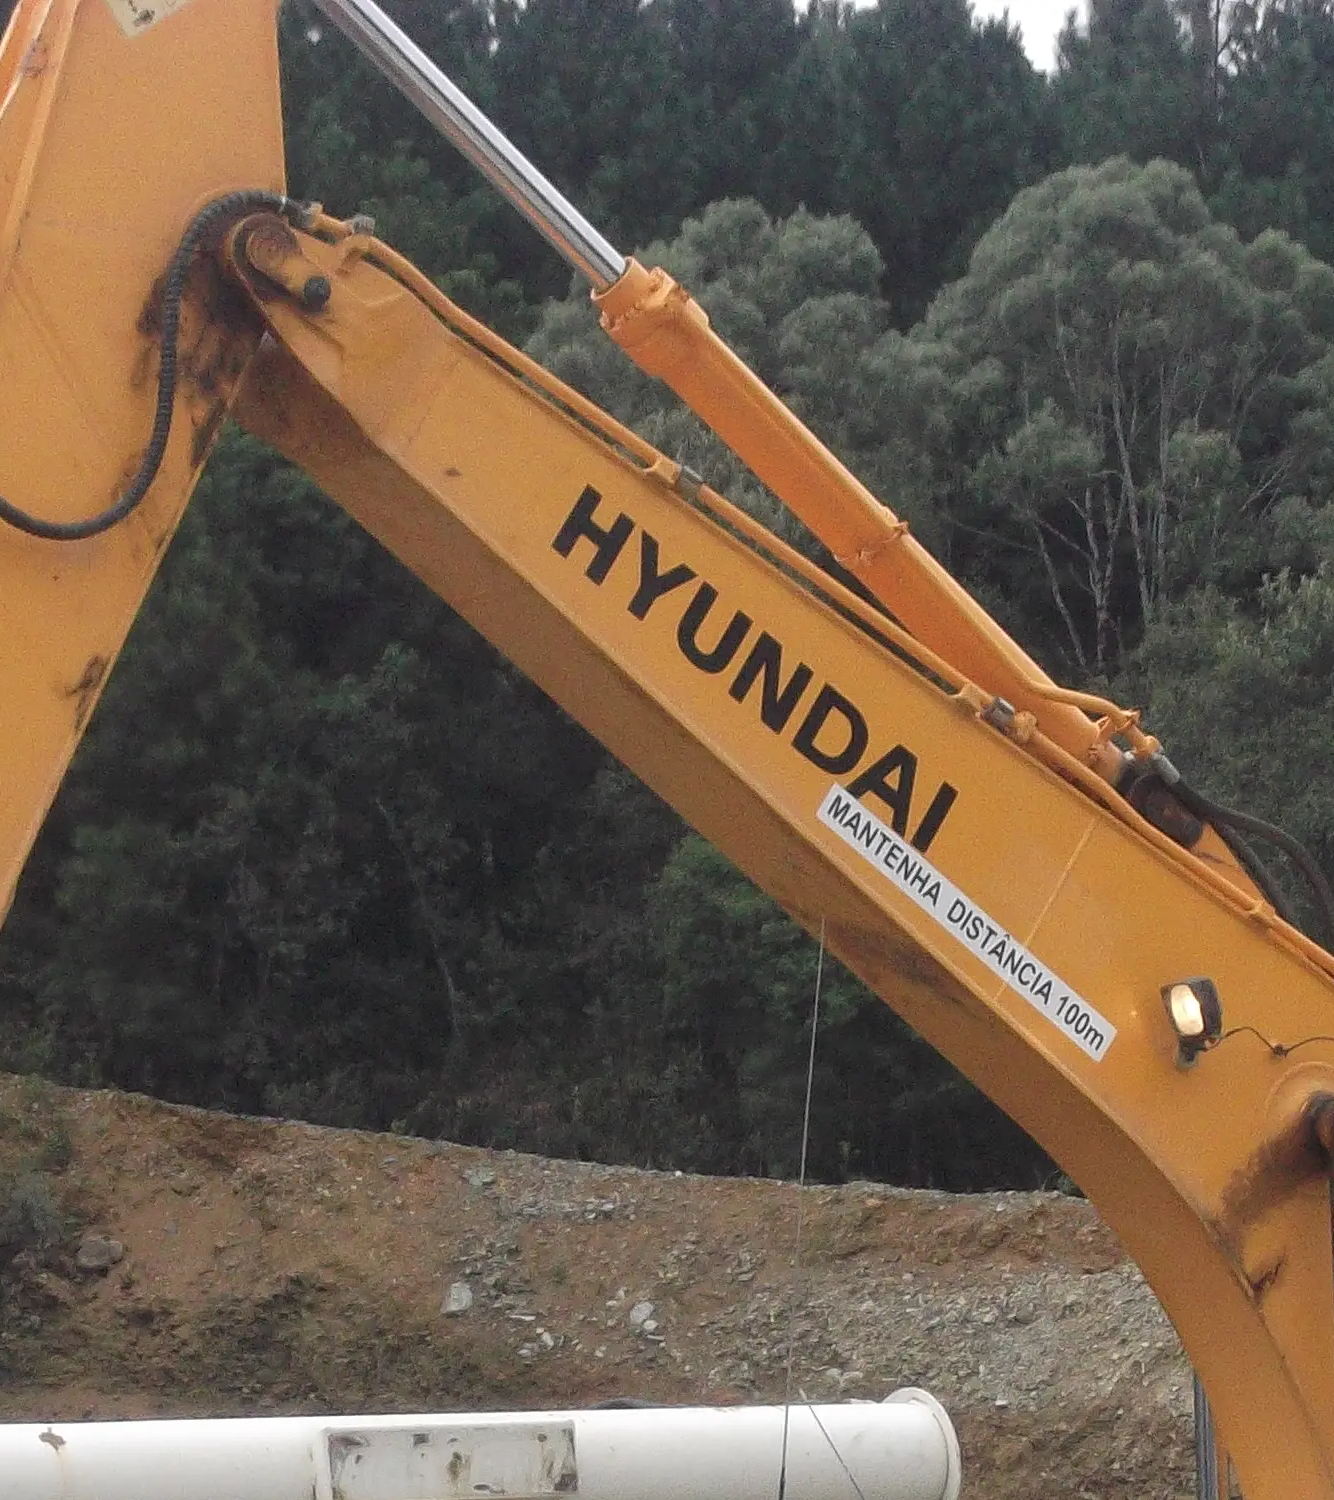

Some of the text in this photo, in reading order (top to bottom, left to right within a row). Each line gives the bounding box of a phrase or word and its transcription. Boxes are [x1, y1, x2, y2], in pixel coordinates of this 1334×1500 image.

[551, 484, 960, 854] HYUNDAI
[828, 796, 1107, 1052] MANTENHA DISTÂNCIA 100m
